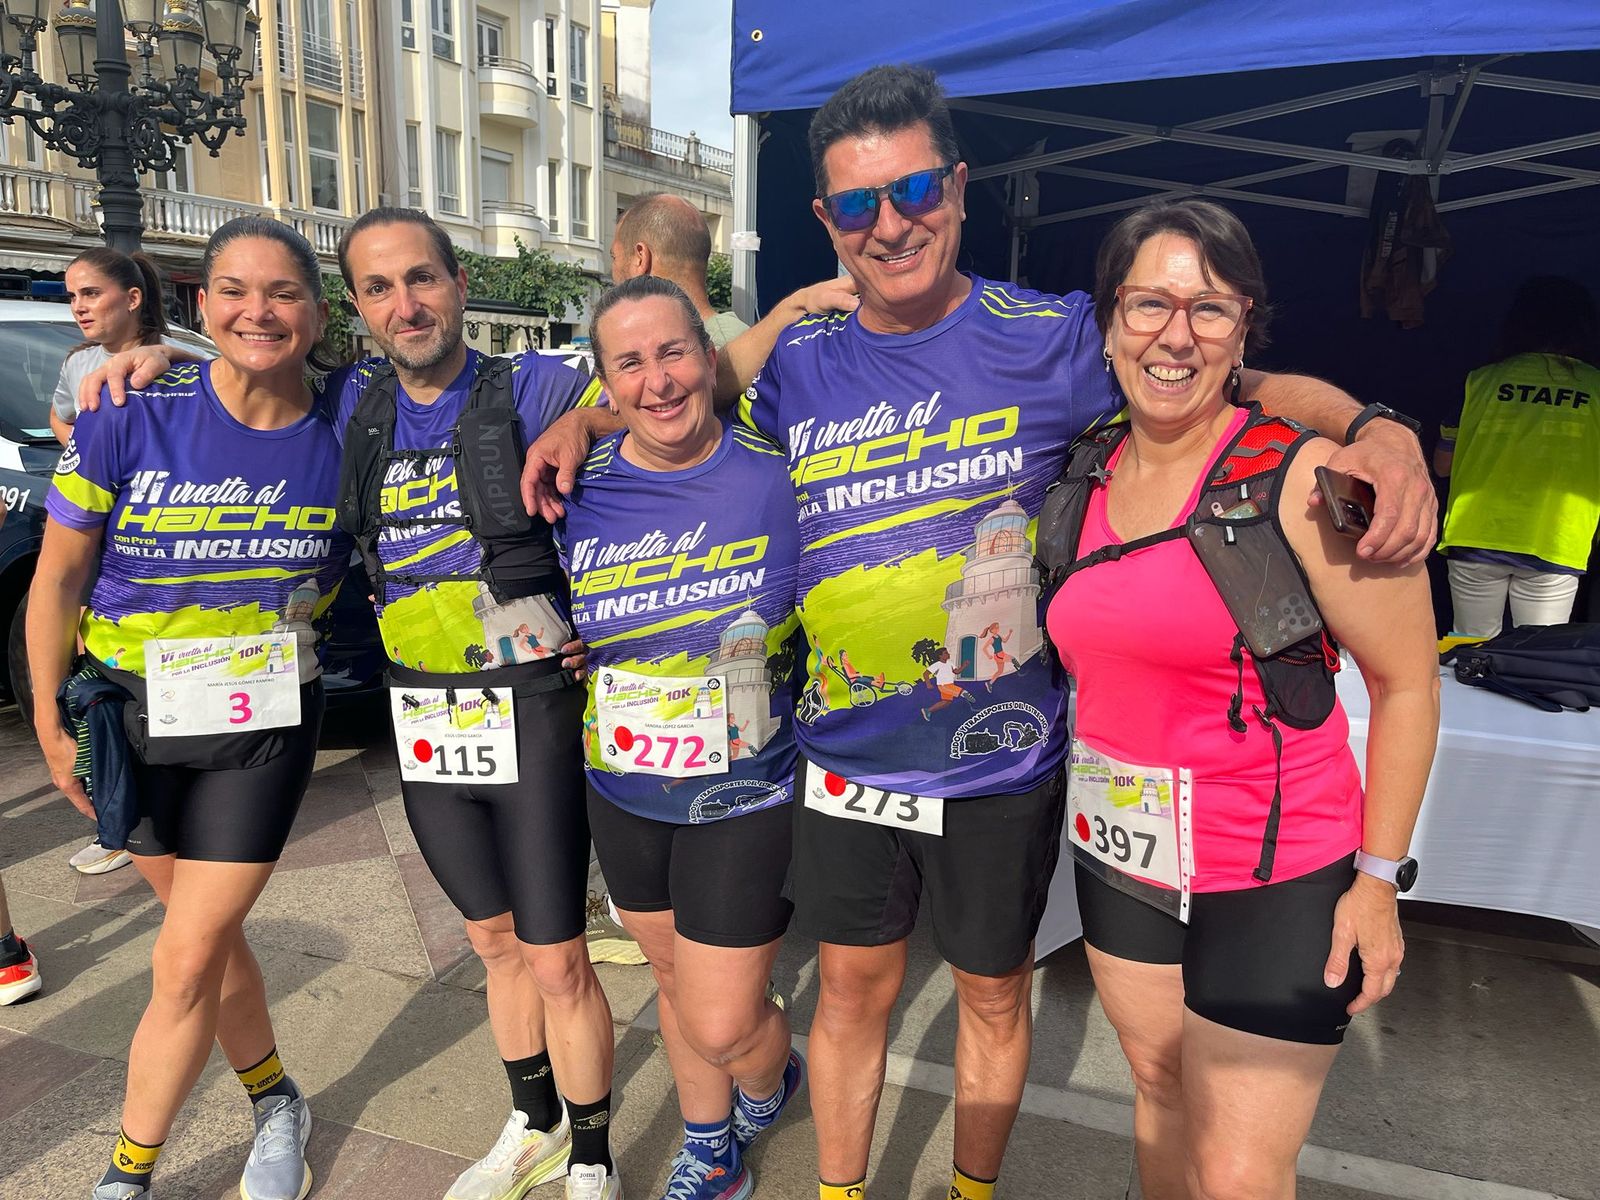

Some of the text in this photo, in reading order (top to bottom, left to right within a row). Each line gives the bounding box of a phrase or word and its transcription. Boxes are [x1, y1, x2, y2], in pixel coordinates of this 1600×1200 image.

[1497, 383, 1590, 409] STAFF
[814, 400, 902, 449] vuelta
[904, 390, 941, 431] al
[169, 476, 253, 504] vuelta
[254, 479, 287, 504] al
[478, 424, 519, 529] KIPRUN
[825, 446, 1023, 512] INCLUSIÓN
[114, 534, 332, 560] POR LA INCLUSIÓN
[596, 529, 673, 567] vuelta
[672, 521, 707, 554] al
[596, 567, 766, 622] INCLUSIÓN
[191, 655, 231, 672] INCLUSIÓN
[237, 643, 265, 660] 10K
[229, 691, 254, 725] 3
[459, 699, 482, 713] 10K
[666, 687, 692, 702] 10K
[962, 701, 1013, 729] TRANSPORTES
[433, 744, 498, 777] 115
[633, 734, 707, 769] 272
[699, 780, 746, 801] TRANSPORTES
[1113, 775, 1137, 787] 10K
[1093, 814, 1158, 870] 397
